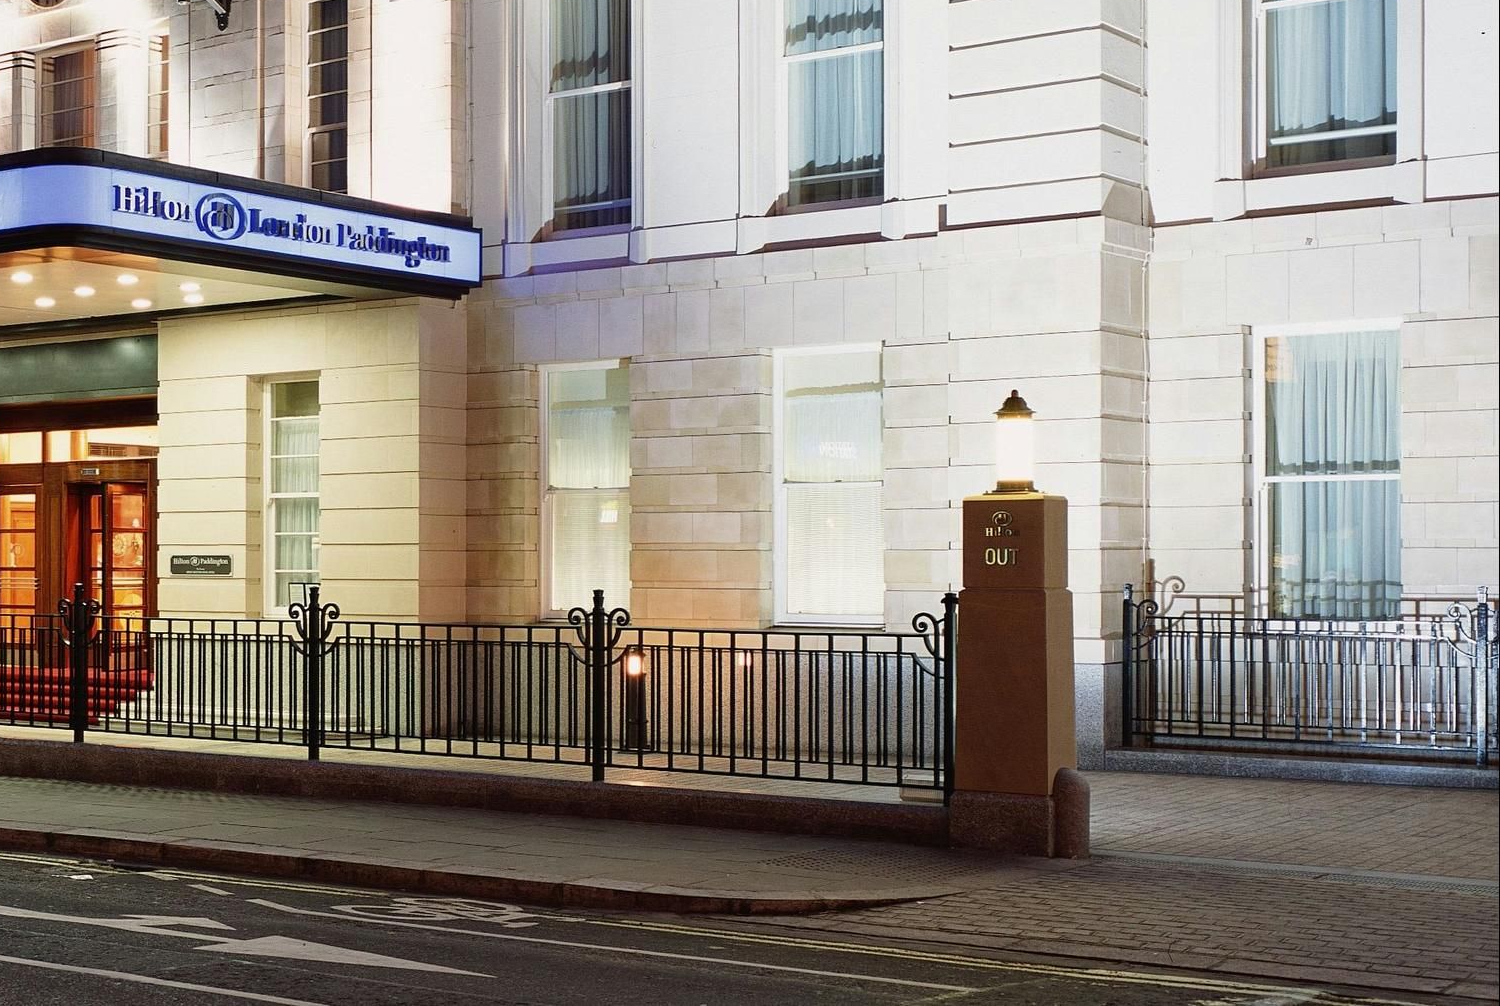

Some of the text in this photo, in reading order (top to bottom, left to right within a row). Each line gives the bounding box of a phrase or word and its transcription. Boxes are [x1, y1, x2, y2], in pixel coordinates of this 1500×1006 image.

[112, 184, 452, 268] Hilton London Paddington
[985, 526, 1020, 537] Hilo
[173, 557, 228, 567] Hilton Paddington
[985, 547, 1019, 566] OUT
